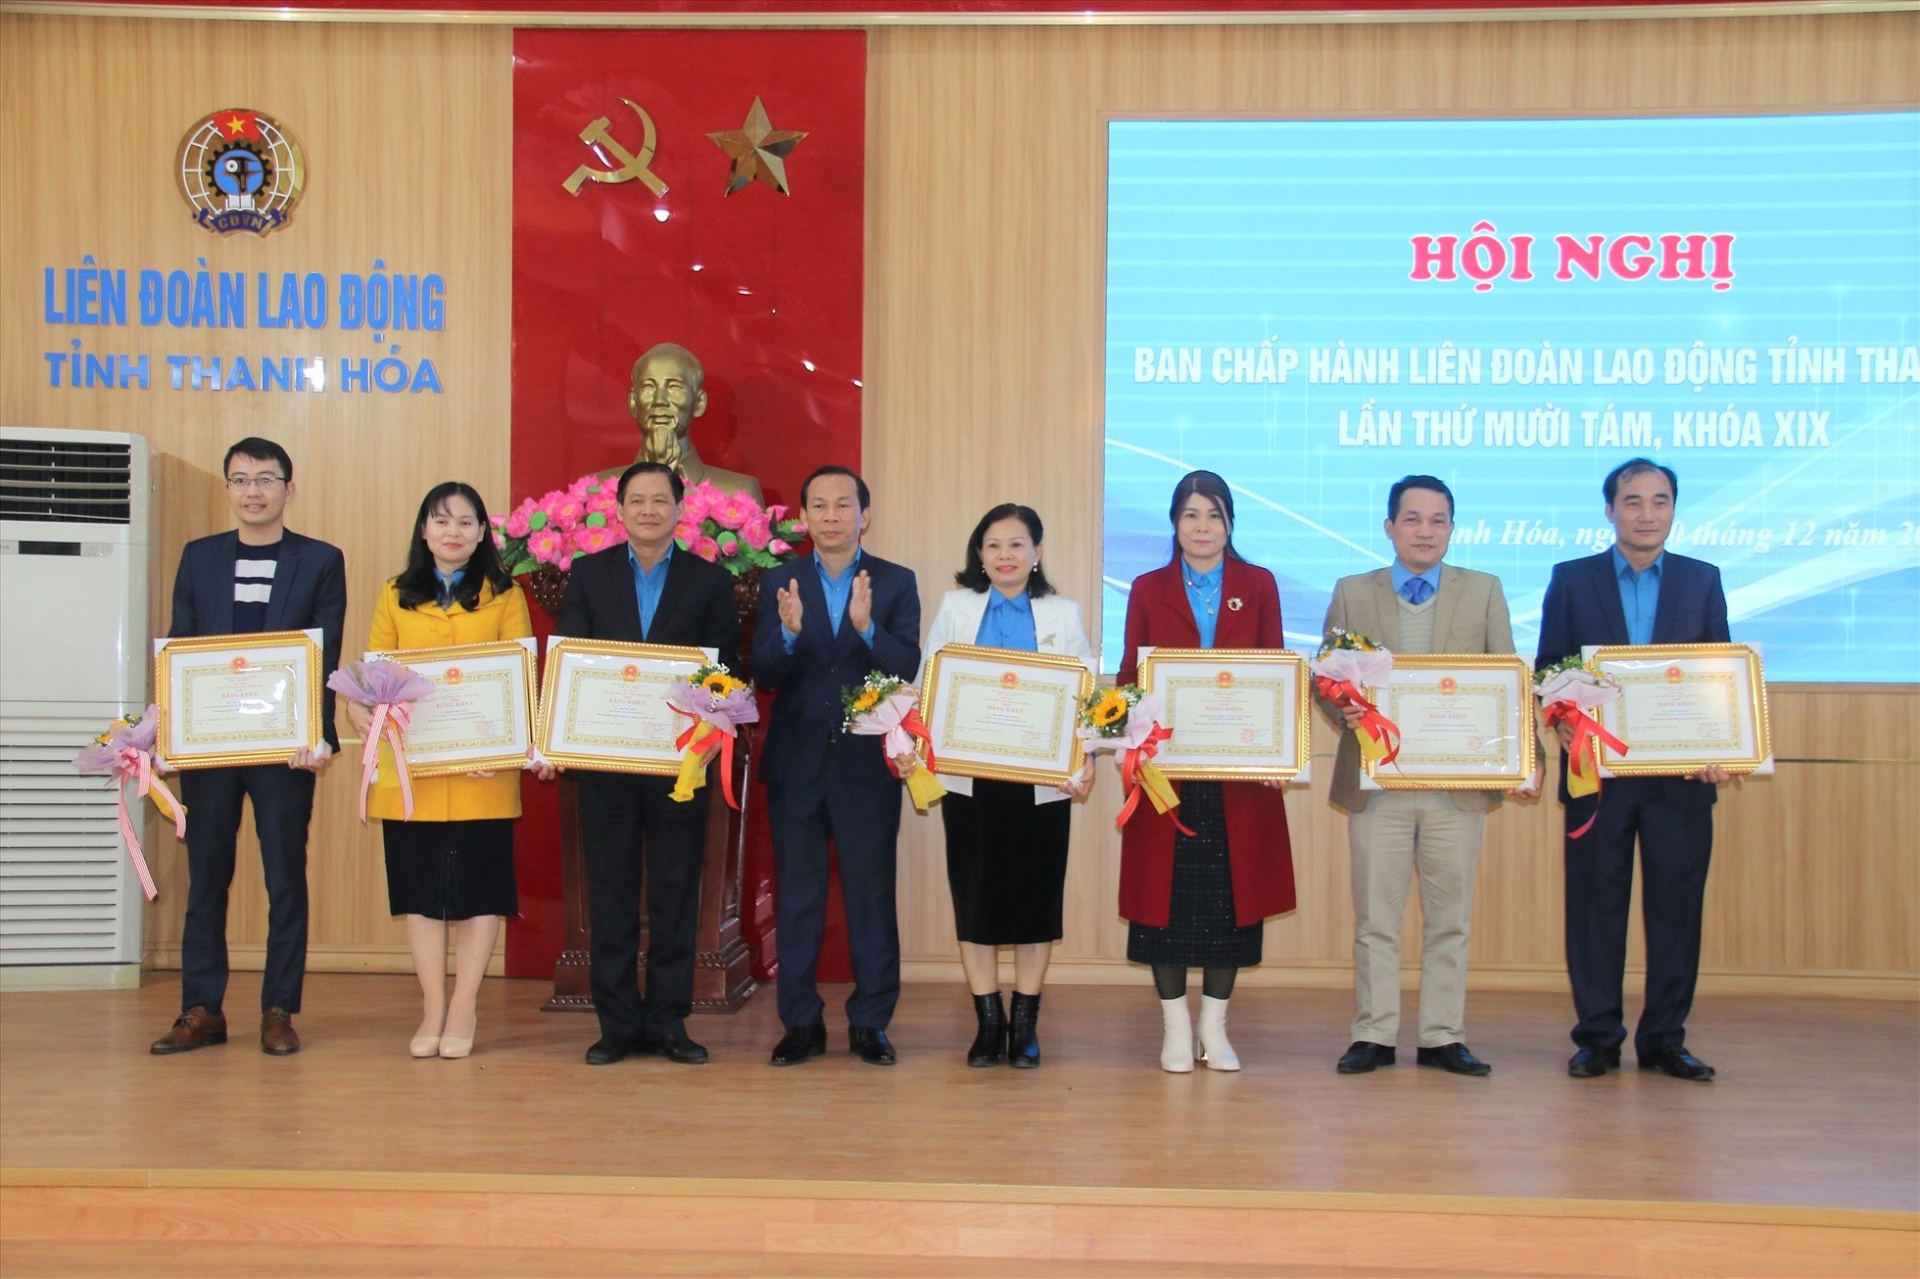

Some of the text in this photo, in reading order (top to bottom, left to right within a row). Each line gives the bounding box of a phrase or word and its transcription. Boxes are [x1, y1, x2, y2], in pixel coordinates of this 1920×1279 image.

[1409, 220, 1736, 292] HỘI NGHỊ
[44, 254, 446, 343] LIÊN ĐOÀN LAO ĐỘNG
[44, 338, 443, 393] TỈNH THANH HÓA
[1133, 333, 1920, 393] BAN CHẤP HÀNH LIÊN ĐOÀN LAO ĐỘNG TỈNH THA
[1338, 397, 1831, 452] LẦN THỨ MƯỜI TÁM, KHÓA XIX
[1499, 518, 1565, 549] Hóa,
[1692, 519, 1774, 554] tháng
[1781, 520, 1818, 546] 12
[1824, 520, 1887, 546] năm
